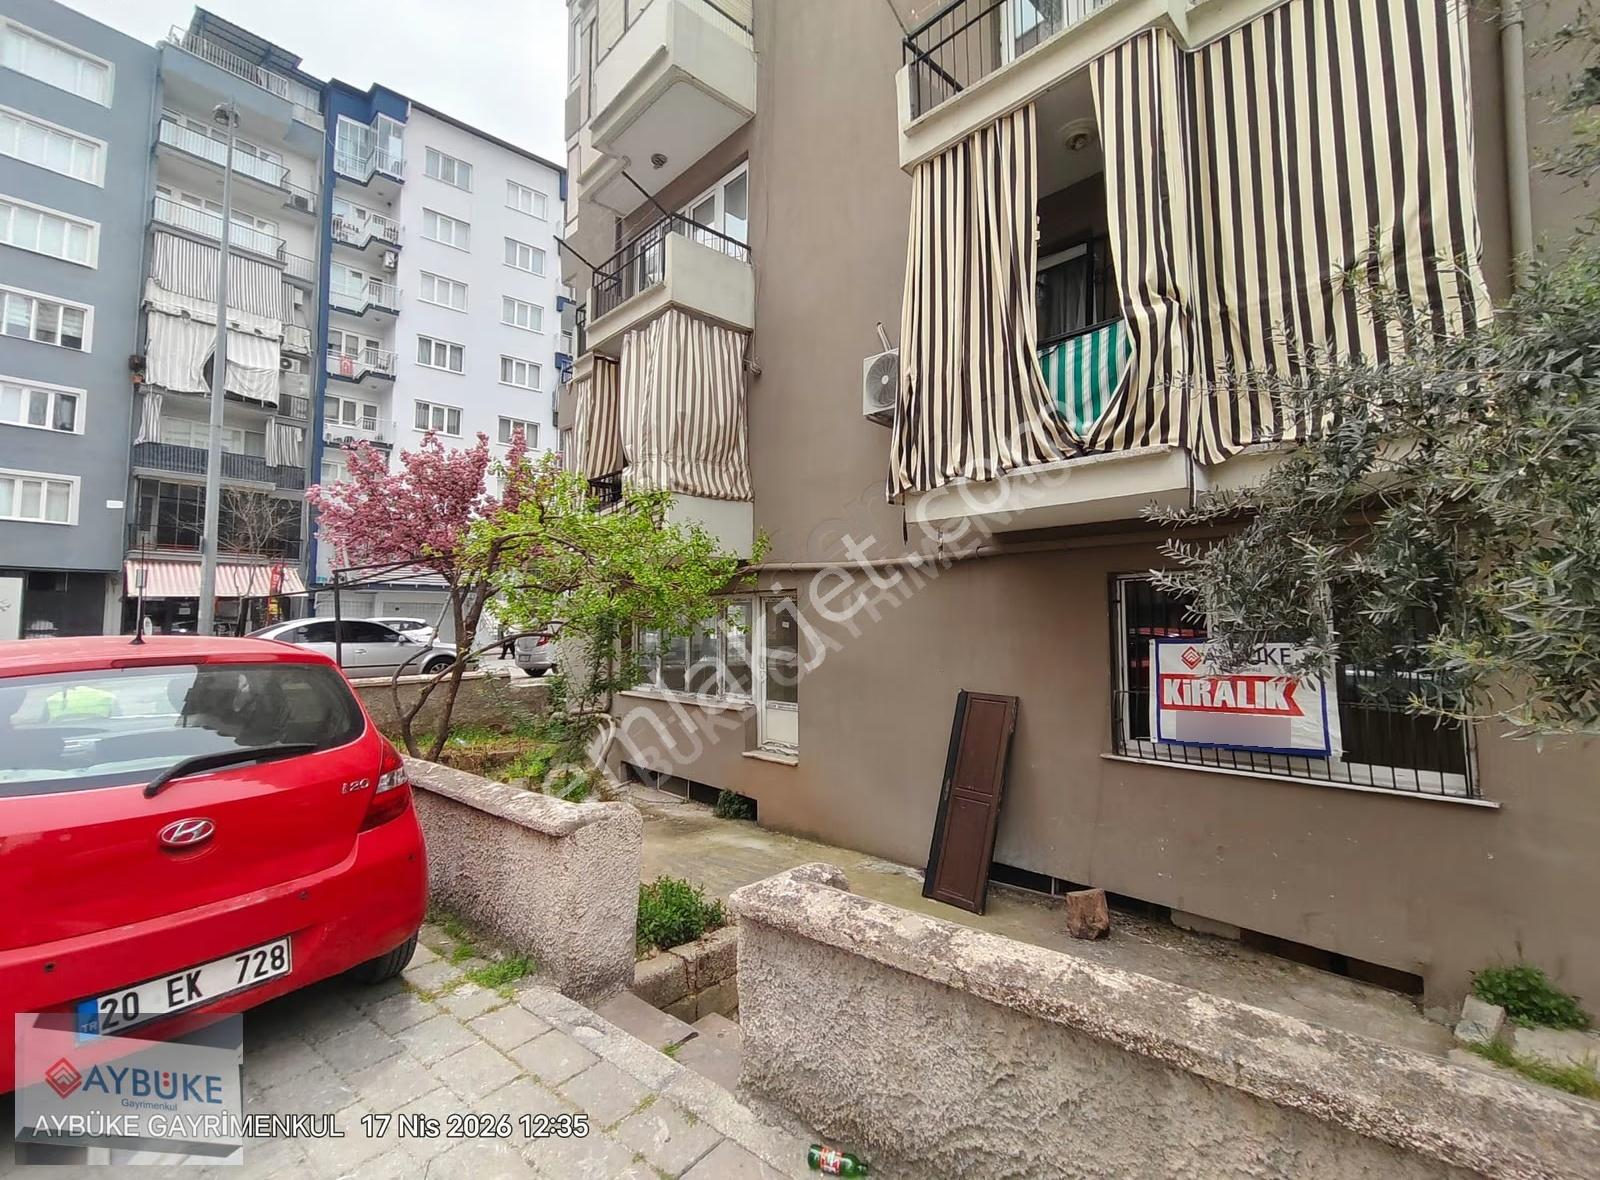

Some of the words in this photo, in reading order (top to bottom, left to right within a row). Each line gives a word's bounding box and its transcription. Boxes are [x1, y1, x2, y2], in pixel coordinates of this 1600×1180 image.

[100, 991, 140, 1030] 20
[167, 969, 204, 1008] EK
[235, 944, 286, 986] 728
